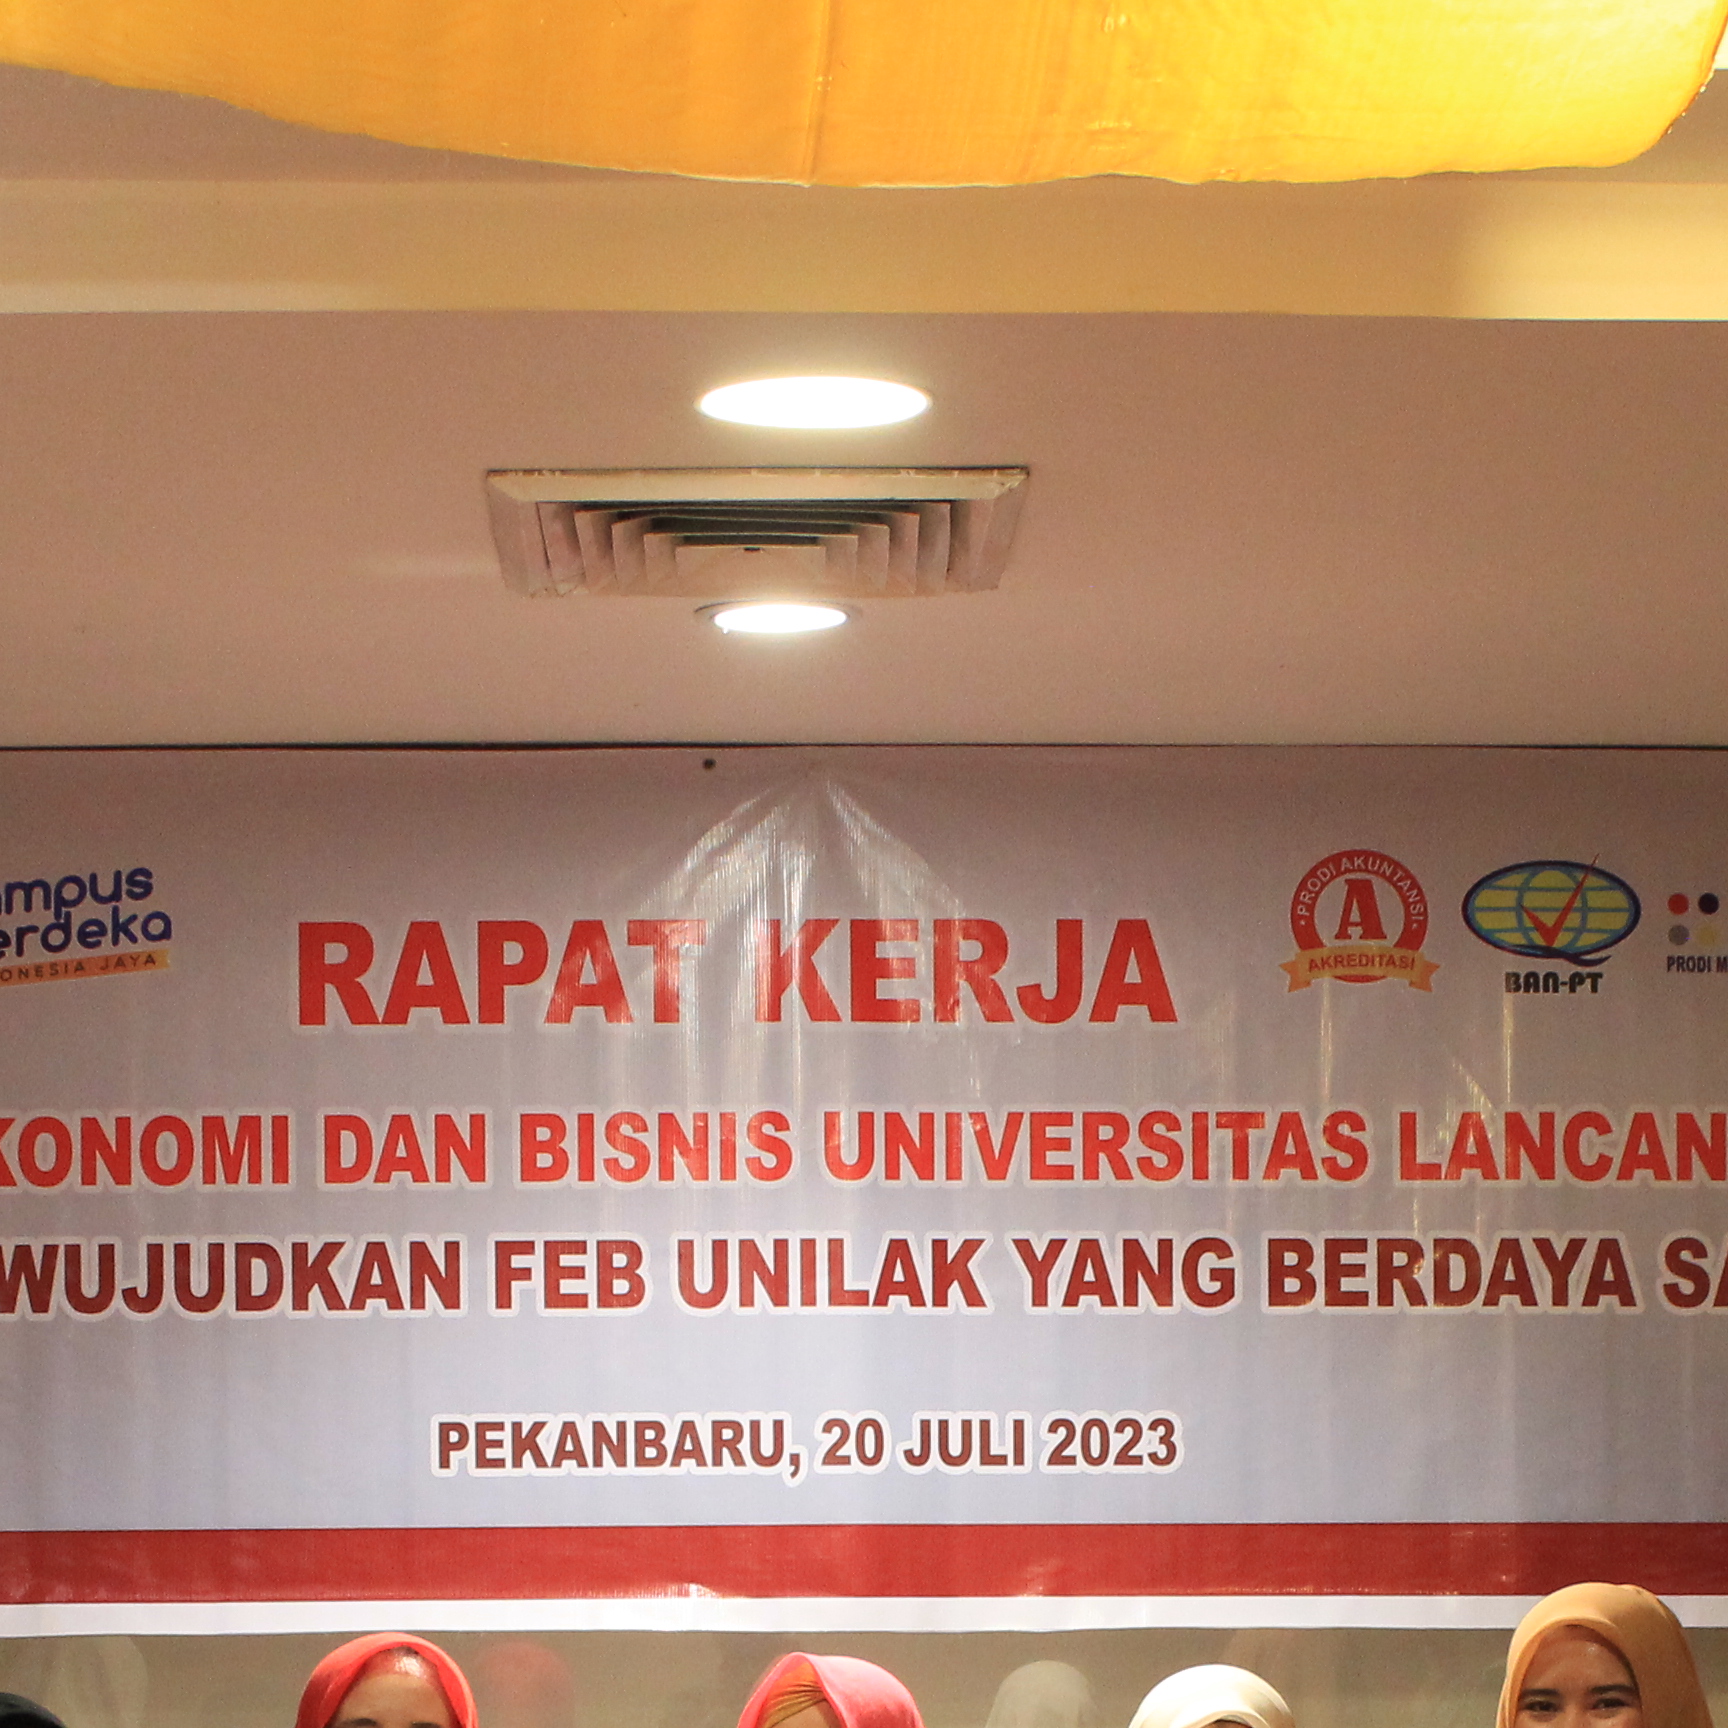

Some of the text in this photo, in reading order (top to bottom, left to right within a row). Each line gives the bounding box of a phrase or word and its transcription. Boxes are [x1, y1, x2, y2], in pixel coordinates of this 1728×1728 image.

[1297, 855, 1425, 920] PRODI AKUNTANSI
[1334, 878, 1388, 940] A
[99, 953, 156, 971] JAYA
[298, 919, 1179, 1027] RAPAT KERJA
[1308, 953, 1416, 974] AKREDITASI
[1504, 970, 1604, 994] BAN-PT
[1666, 955, 1712, 973] PRODI
[323, 1114, 488, 1186] DAN
[520, 1111, 794, 1184] BISNIS
[824, 1111, 1370, 1184] UNIVERSITAS
[494, 1240, 645, 1310] FEB
[677, 1238, 988, 1309] UNILAK
[1011, 1238, 1237, 1310] YANG
[1267, 1238, 1638, 1309] BERDAYA
[438, 1417, 1179, 1478] PEKANBARU, 20 JULI 2023
